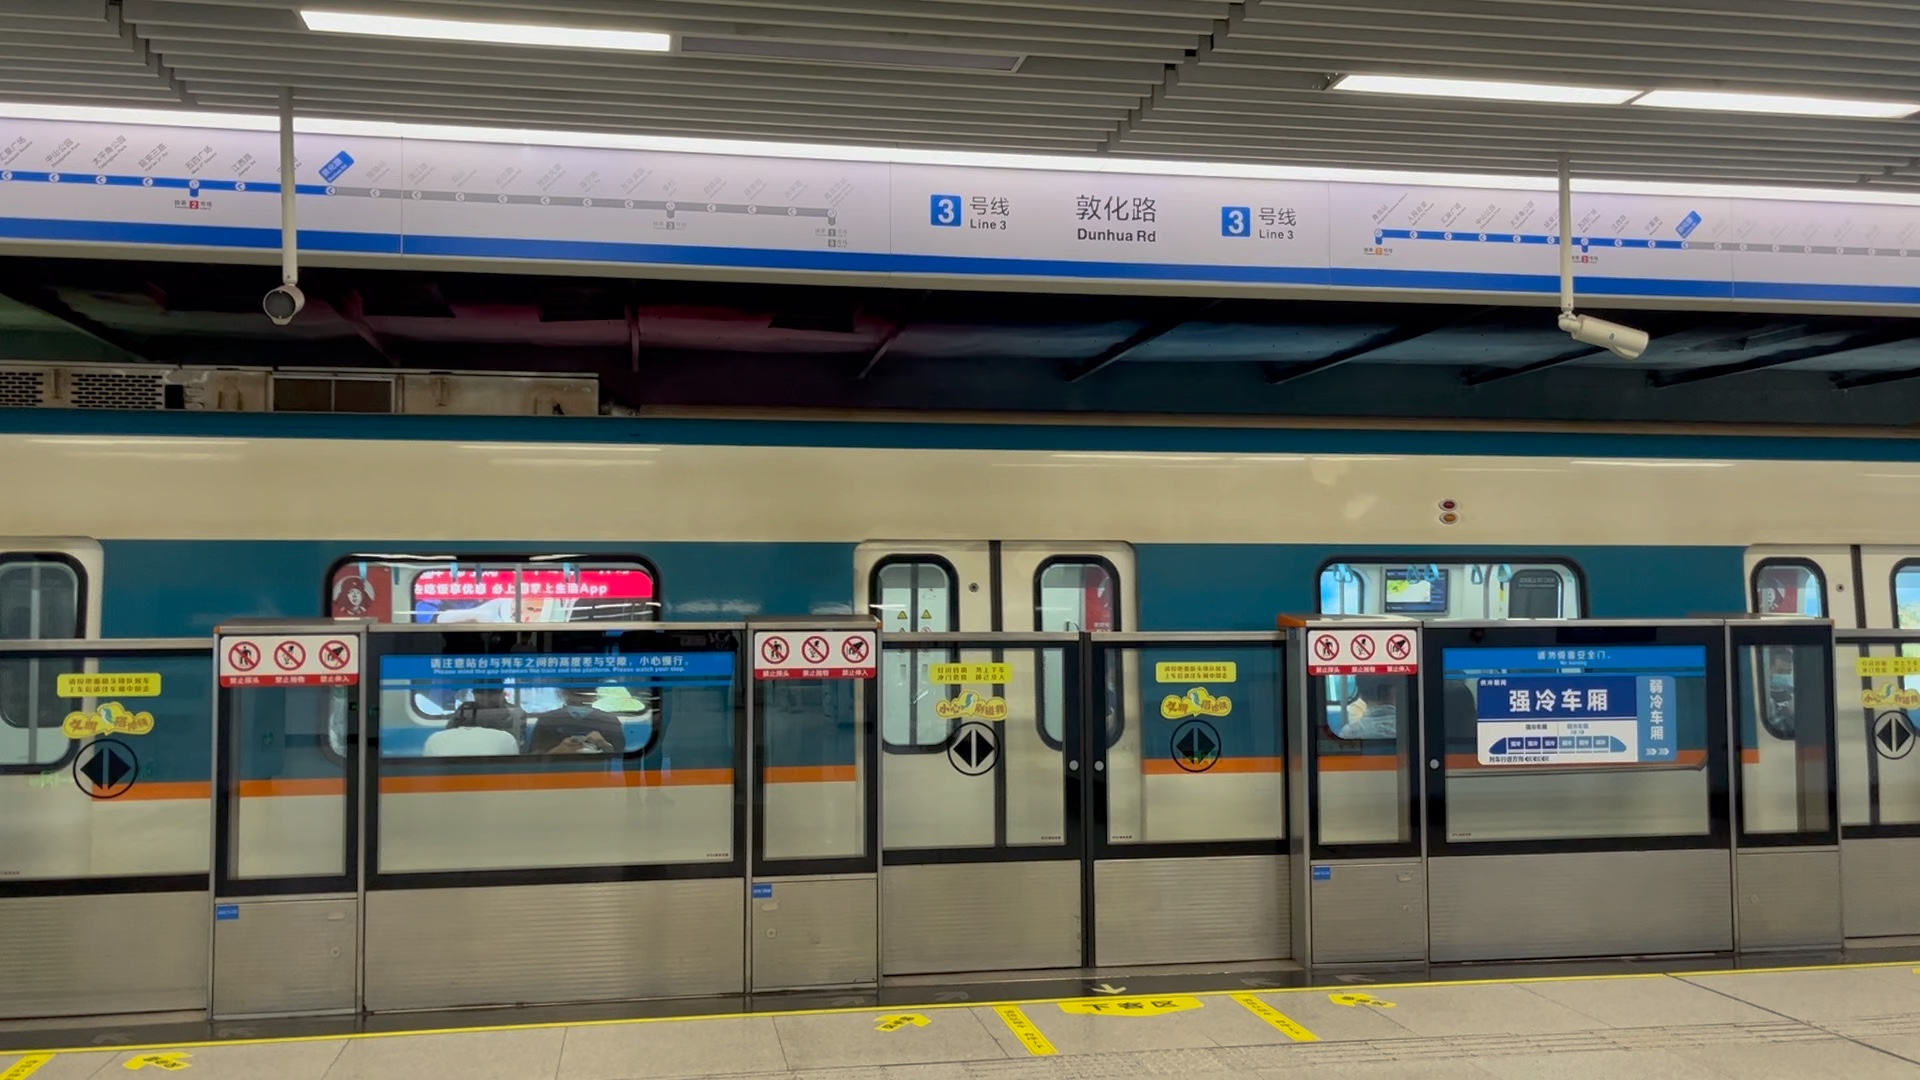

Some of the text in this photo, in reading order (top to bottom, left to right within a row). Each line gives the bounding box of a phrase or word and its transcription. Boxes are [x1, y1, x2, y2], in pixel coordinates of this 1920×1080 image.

[45, 137, 74, 163] 中山公园
[185, 145, 213, 170] 五四广场
[937, 195, 1010, 224] 3 号线
[1075, 193, 1157, 223] 敦化路
[1227, 207, 1297, 234] 3 号线
[970, 218, 1007, 230] Line 3
[1077, 228, 1157, 243] Dunhua Rd
[1259, 229, 1295, 240] Line 3
[1509, 688, 1609, 713] 强冷车厢
[1649, 679, 1664, 741] 弱冷车厢
